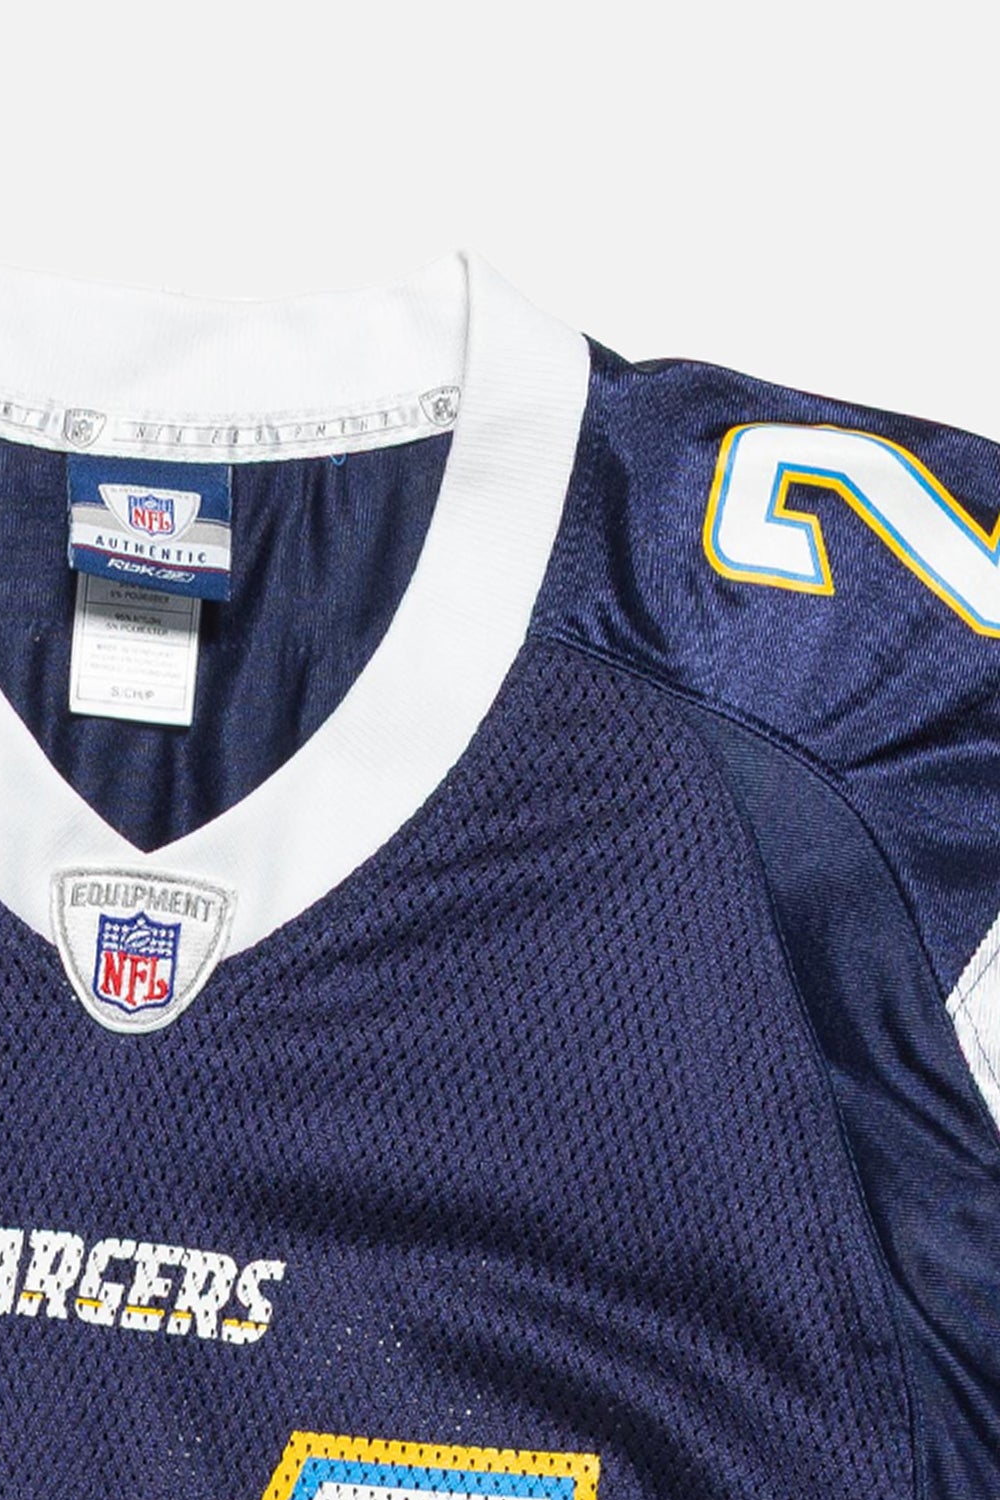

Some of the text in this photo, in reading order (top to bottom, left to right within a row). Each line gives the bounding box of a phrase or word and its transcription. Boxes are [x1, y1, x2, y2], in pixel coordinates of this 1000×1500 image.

[132, 507, 172, 533] NFL
[95, 534, 208, 563] AUTHENTIC
[71, 882, 215, 923] EQUIPMENT
[100, 950, 169, 1006] NFL
